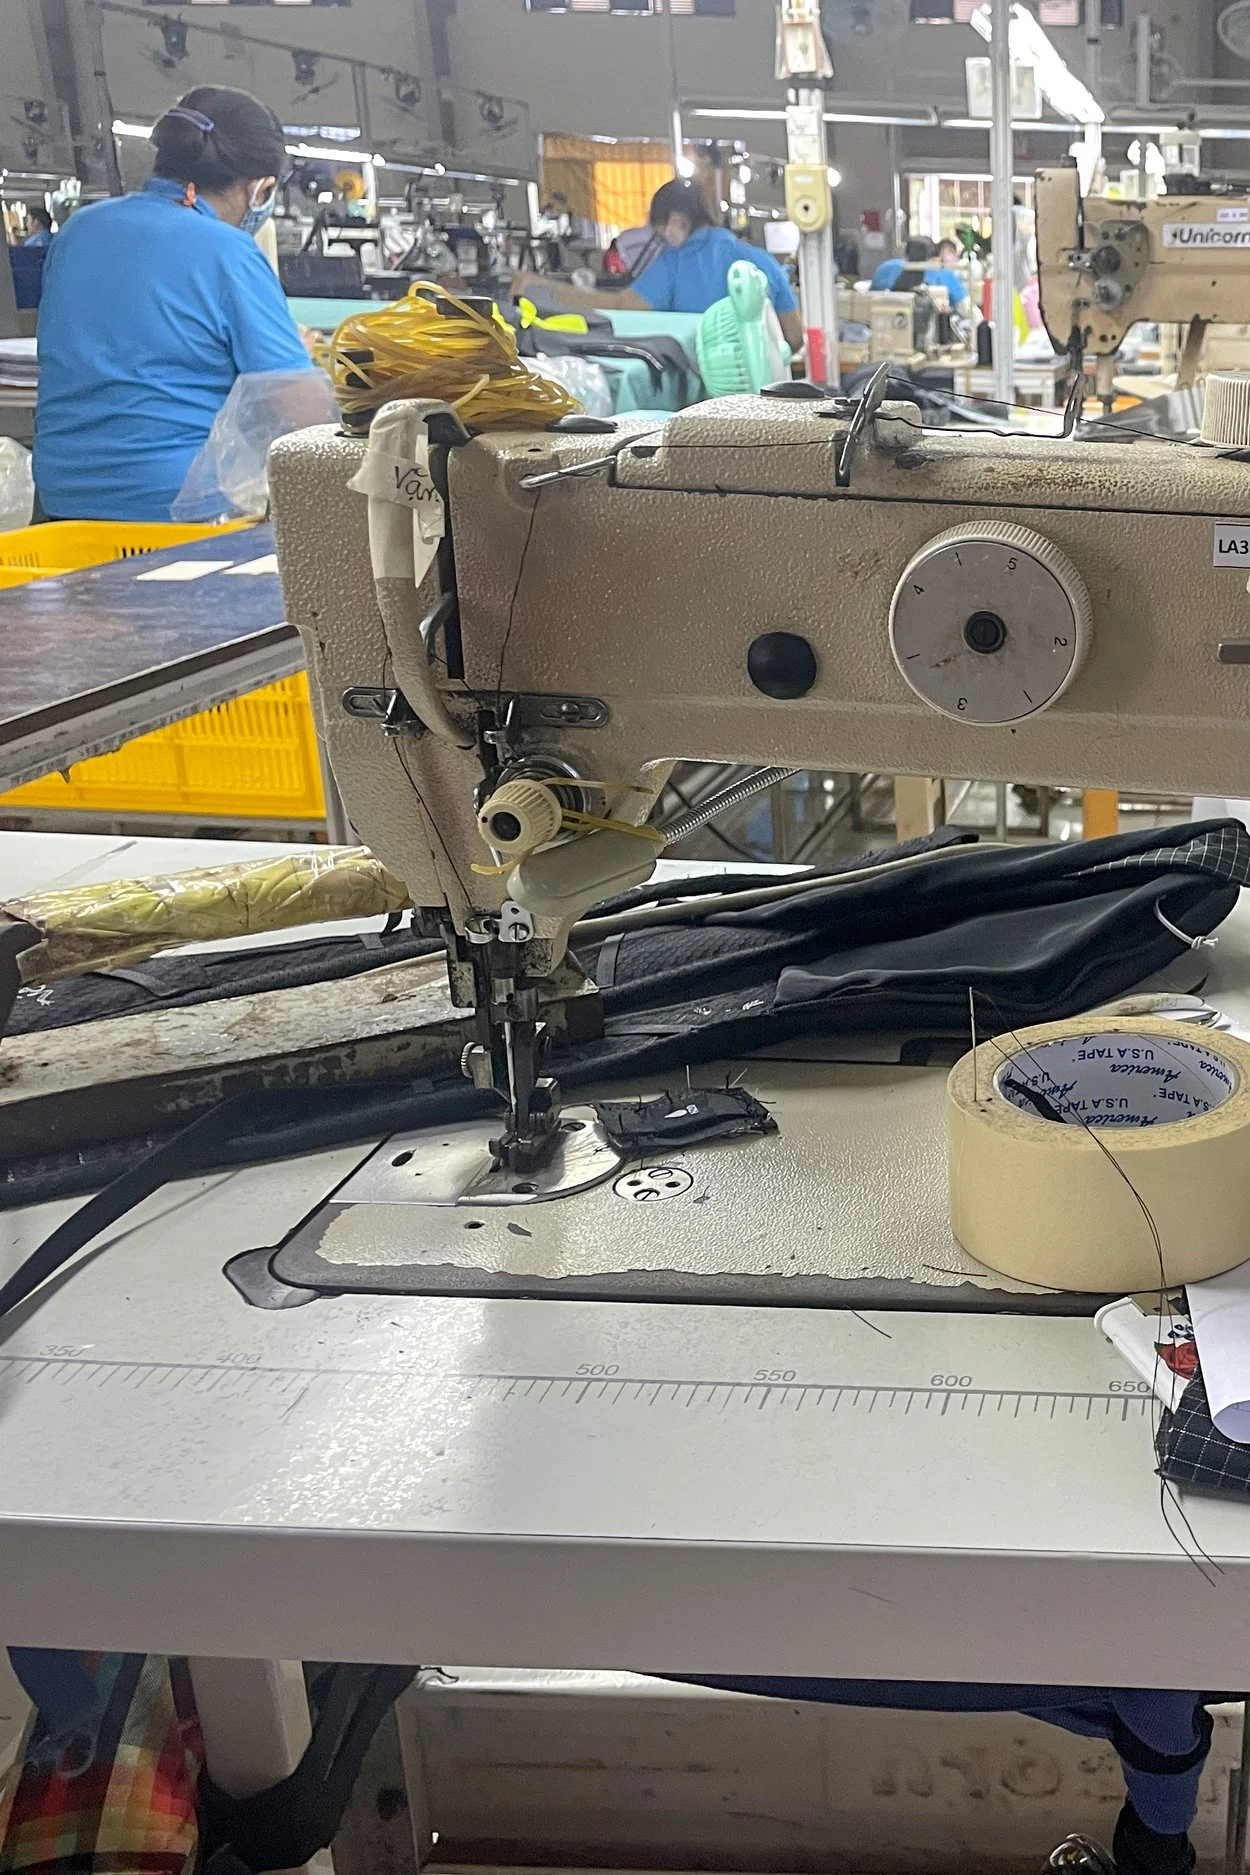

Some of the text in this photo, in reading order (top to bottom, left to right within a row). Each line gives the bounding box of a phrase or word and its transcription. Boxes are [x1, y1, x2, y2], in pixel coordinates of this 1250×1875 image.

[1219, 539, 1249, 554] LA3
[1007, 557, 1017, 569] 5
[913, 584, 924, 595] 4
[1054, 637, 1068, 646] 2
[957, 698, 968, 710] 3
[1077, 1048, 1154, 1060] U.S.A TAPE
[1110, 1064, 1182, 1083] America
[1158, 1087, 1191, 1103] TAPE
[1093, 1098, 1128, 1109] U.S.A
[575, 1364, 620, 1376] 500
[753, 1369, 797, 1382] 550
[930, 1374, 973, 1387] 600
[1108, 1380, 1150, 1393] 650
